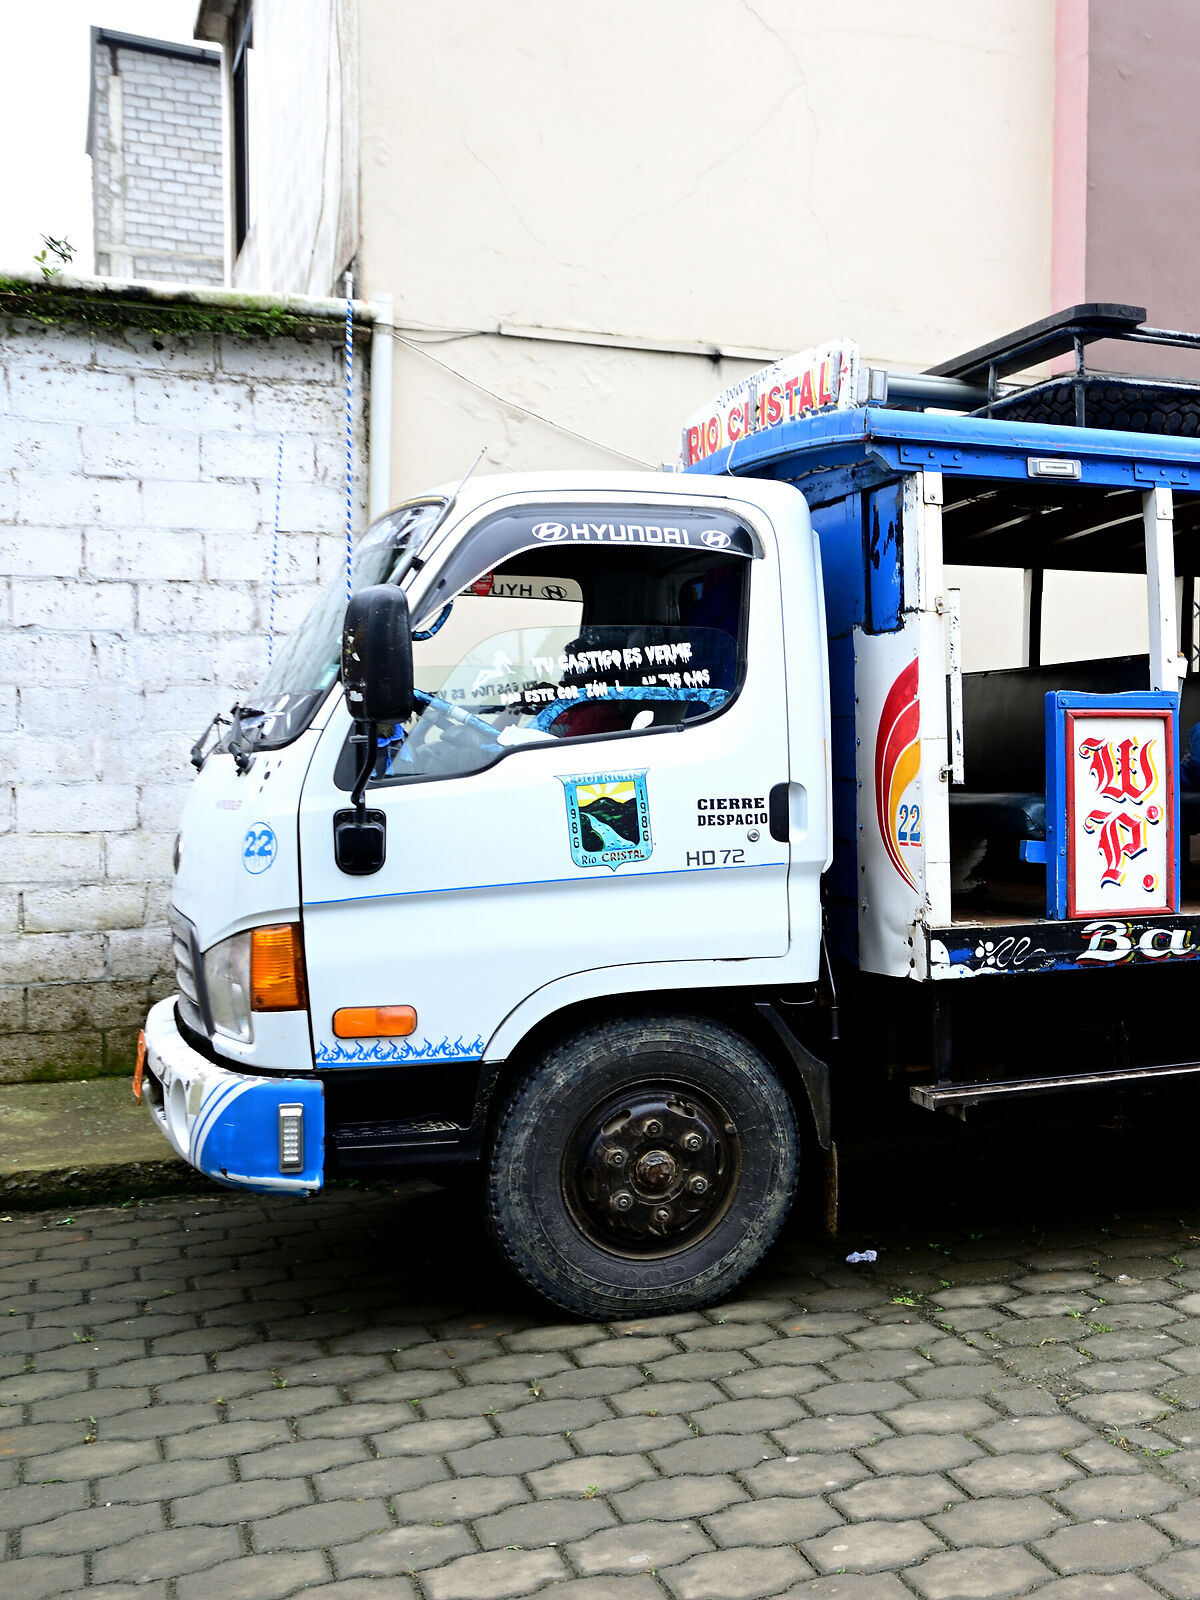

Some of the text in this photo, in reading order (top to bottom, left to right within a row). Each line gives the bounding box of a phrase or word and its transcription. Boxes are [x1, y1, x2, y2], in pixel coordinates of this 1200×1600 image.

[688, 416, 721, 466] RIO
[571, 523, 690, 546] HYUNDAI
[622, 647, 643, 671] ES
[524, 688, 555, 703] ESTE
[697, 797, 766, 811] CIERRE
[697, 812, 769, 827] DESPACIO
[897, 803, 923, 847] 22
[244, 830, 273, 857] 22
[601, 849, 645, 863] CRISTAL
